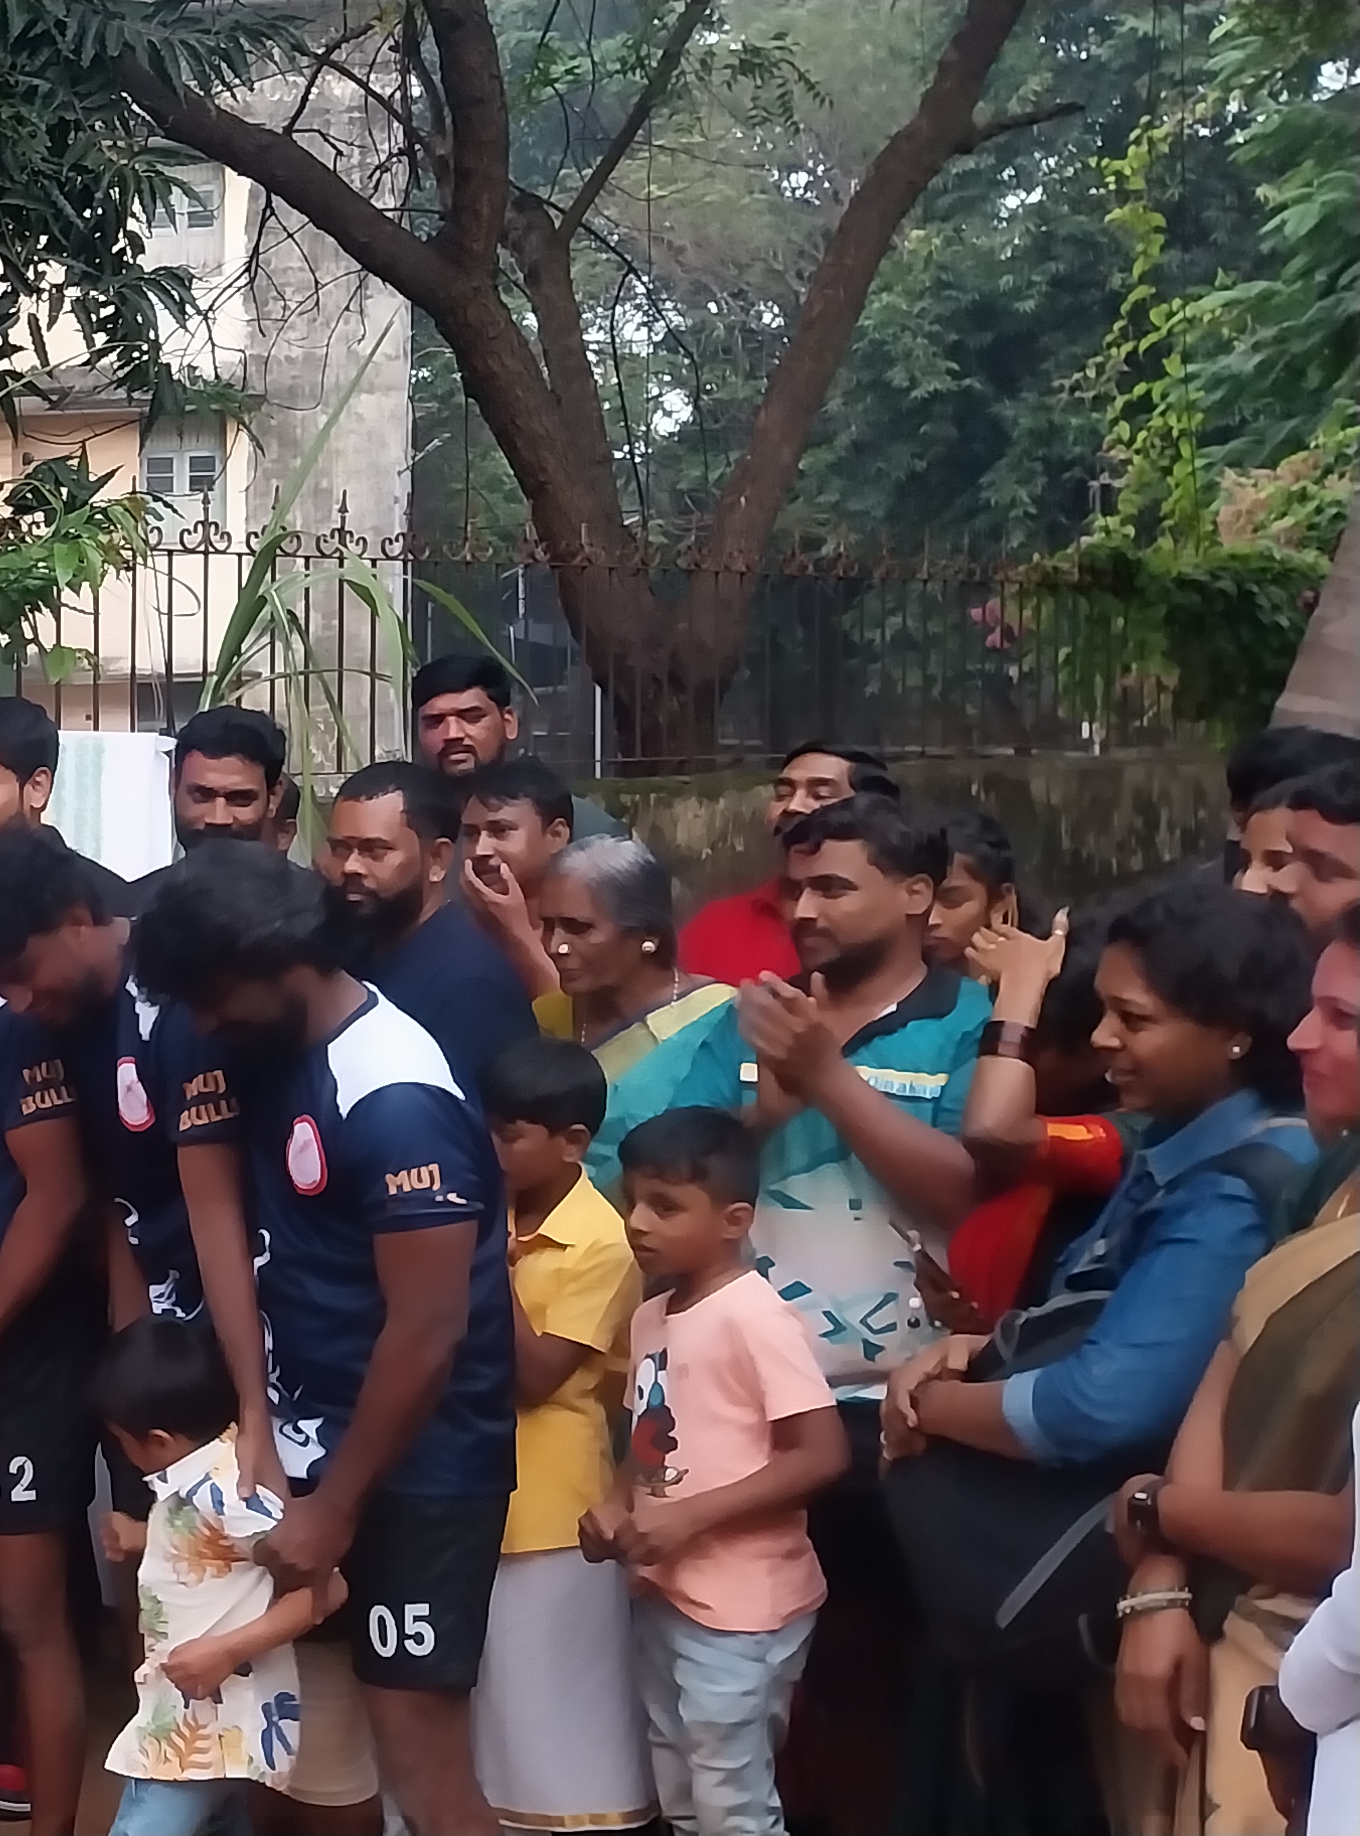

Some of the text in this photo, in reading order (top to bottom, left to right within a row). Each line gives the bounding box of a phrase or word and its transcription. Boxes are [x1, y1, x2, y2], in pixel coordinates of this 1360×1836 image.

[22, 1059, 65, 1085] MUJ
[182, 1069, 226, 1101] MUJ
[385, 1163, 441, 1196] MUJ
[369, 1603, 435, 1658] 05
